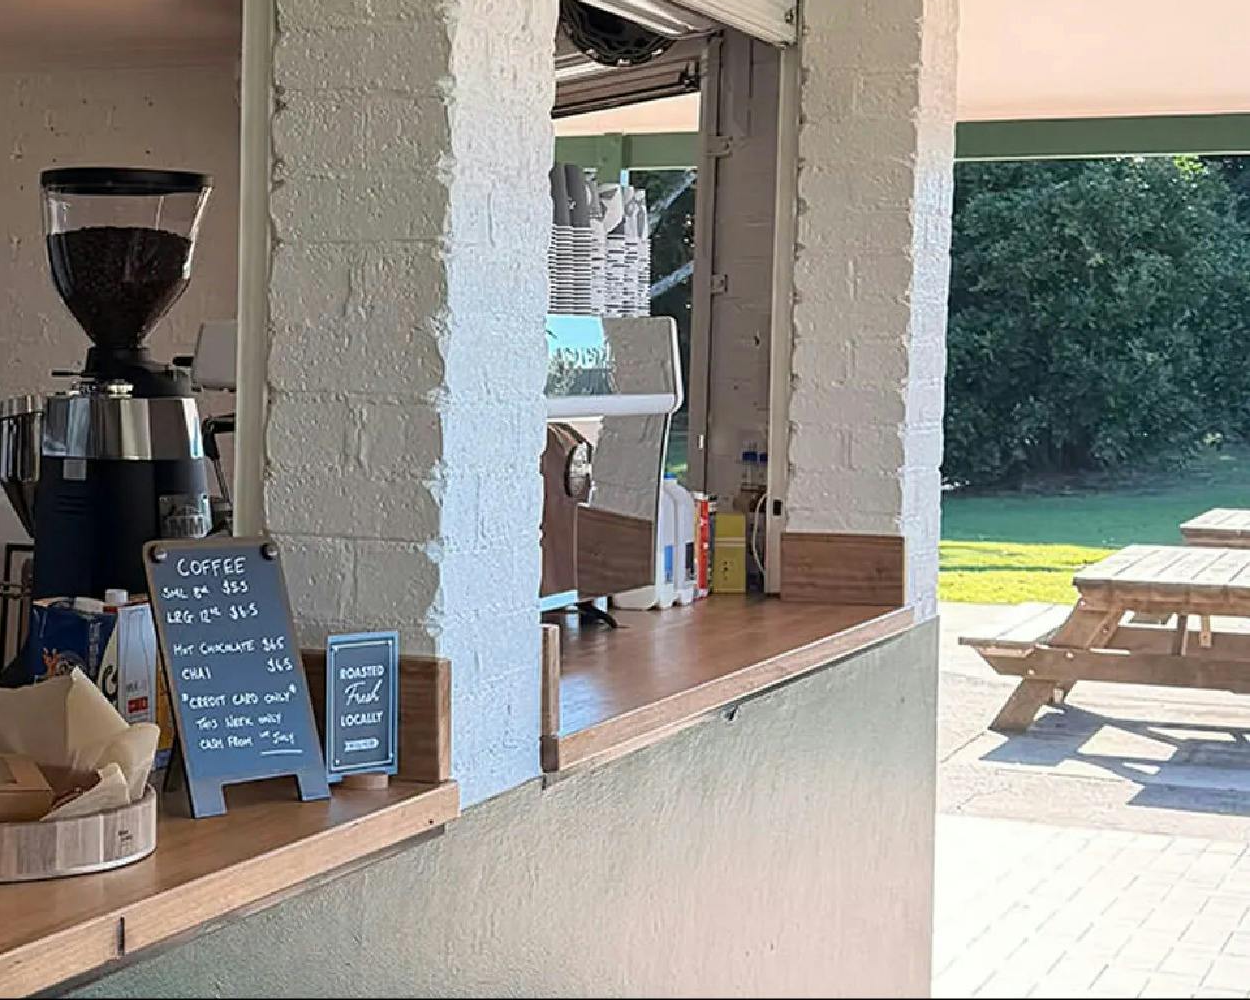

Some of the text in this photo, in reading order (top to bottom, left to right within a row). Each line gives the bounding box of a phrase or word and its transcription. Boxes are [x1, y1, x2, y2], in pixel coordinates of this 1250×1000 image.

[176, 557, 247, 577] COFFEE
[181, 666, 212, 680] CHAI
[339, 665, 384, 680] ROASTED
[340, 711, 383, 727] LOCALLY
